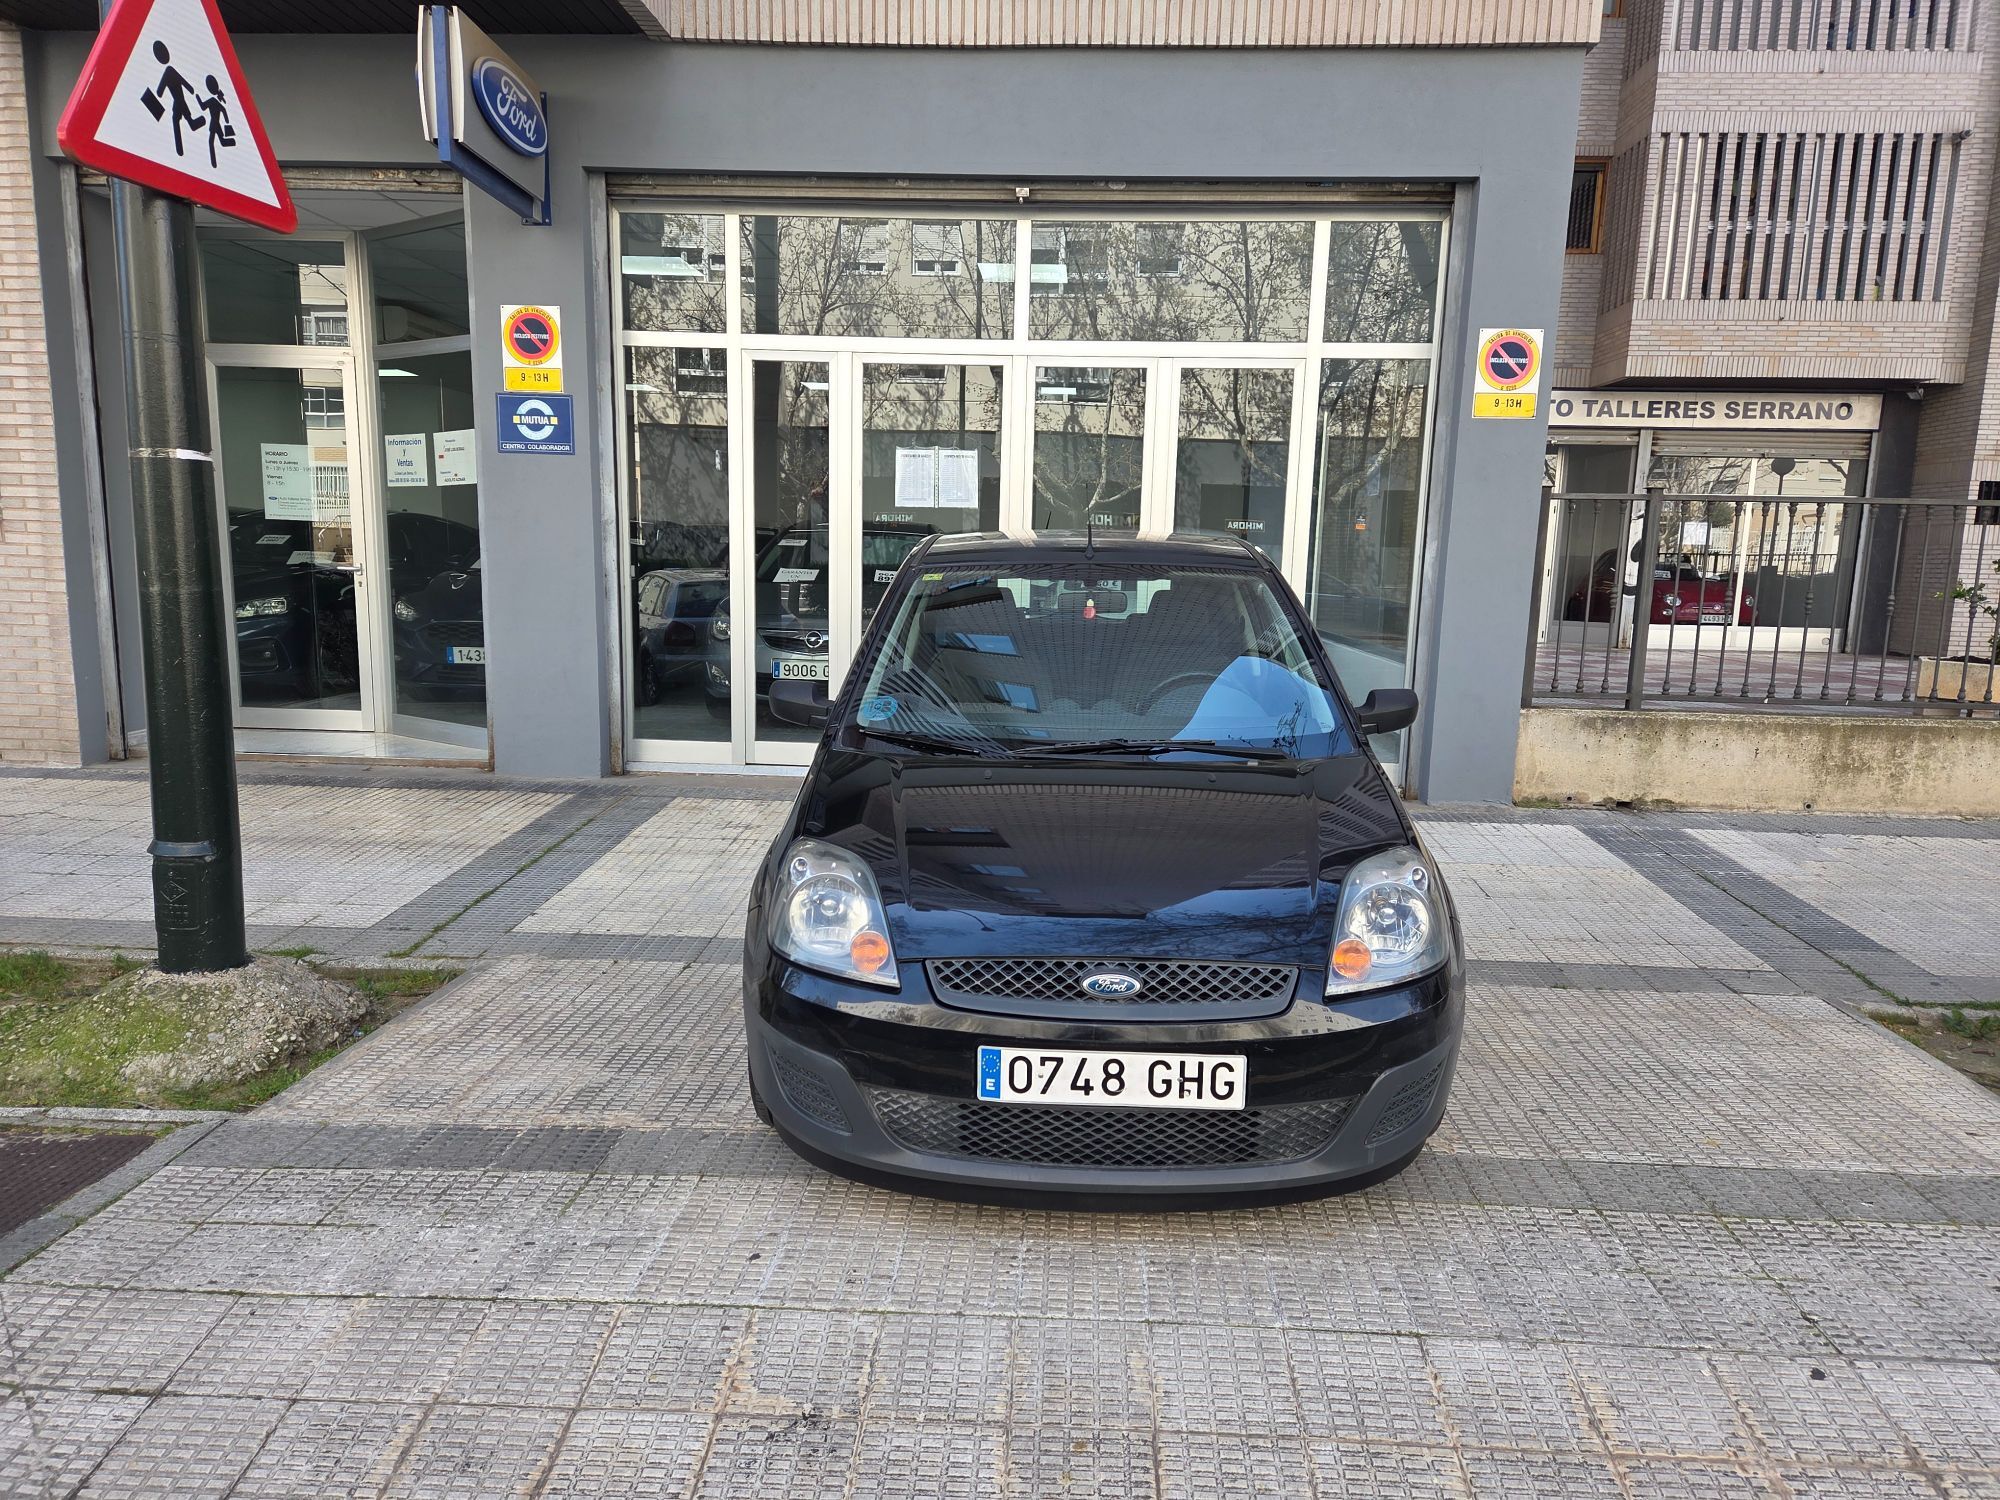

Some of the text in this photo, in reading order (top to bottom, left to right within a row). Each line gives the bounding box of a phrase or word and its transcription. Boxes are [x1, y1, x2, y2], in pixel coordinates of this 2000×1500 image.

[496, 75, 537, 142] Ford
[1582, 399, 1715, 419] TALLERES
[1724, 401, 1854, 420] SERRANO
[521, 415, 549, 425] MUTUA
[388, 438, 422, 446] Información
[527, 443, 570, 451] COLABORADOR
[397, 458, 414, 467] Ventas
[783, 664, 818, 678] 9006
[1096, 977, 1128, 993] Ford
[985, 1055, 1236, 1100] E 0748 GHG
